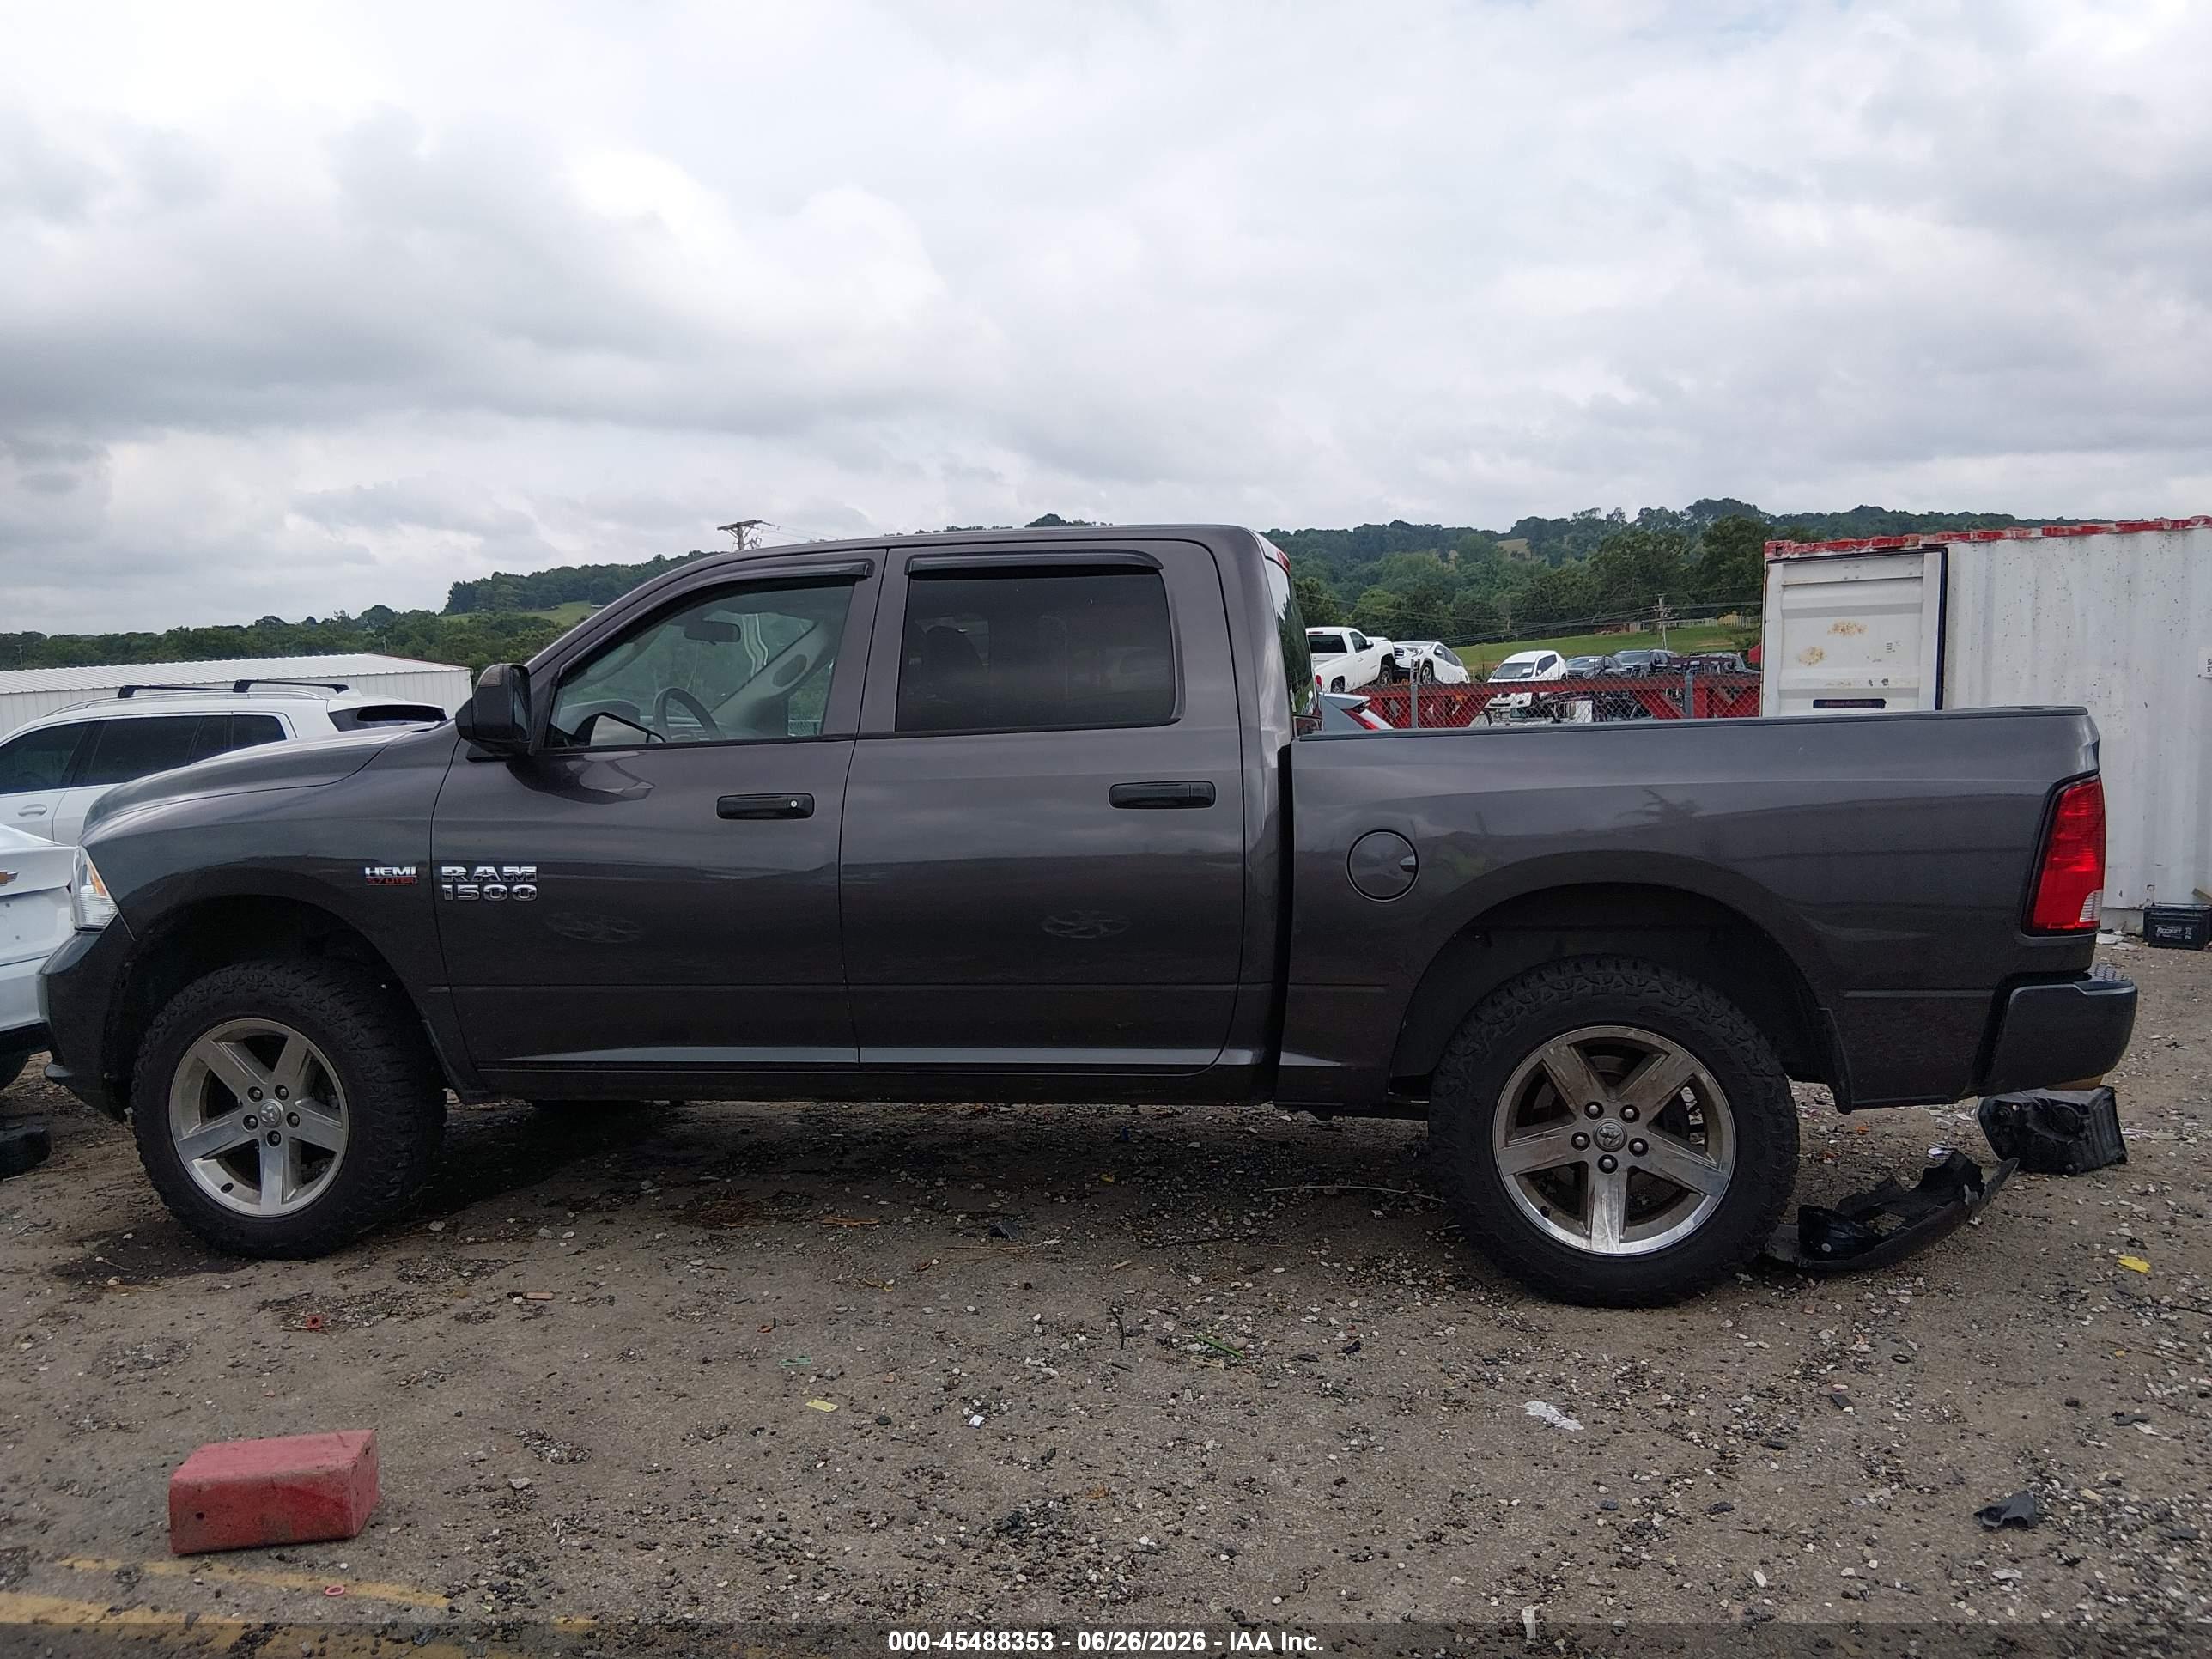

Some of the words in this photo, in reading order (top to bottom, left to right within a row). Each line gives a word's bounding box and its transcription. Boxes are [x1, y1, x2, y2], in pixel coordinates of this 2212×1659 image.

[364, 866, 417, 877] HEMI
[441, 866, 538, 882] RAM
[441, 884, 538, 901] 1500
